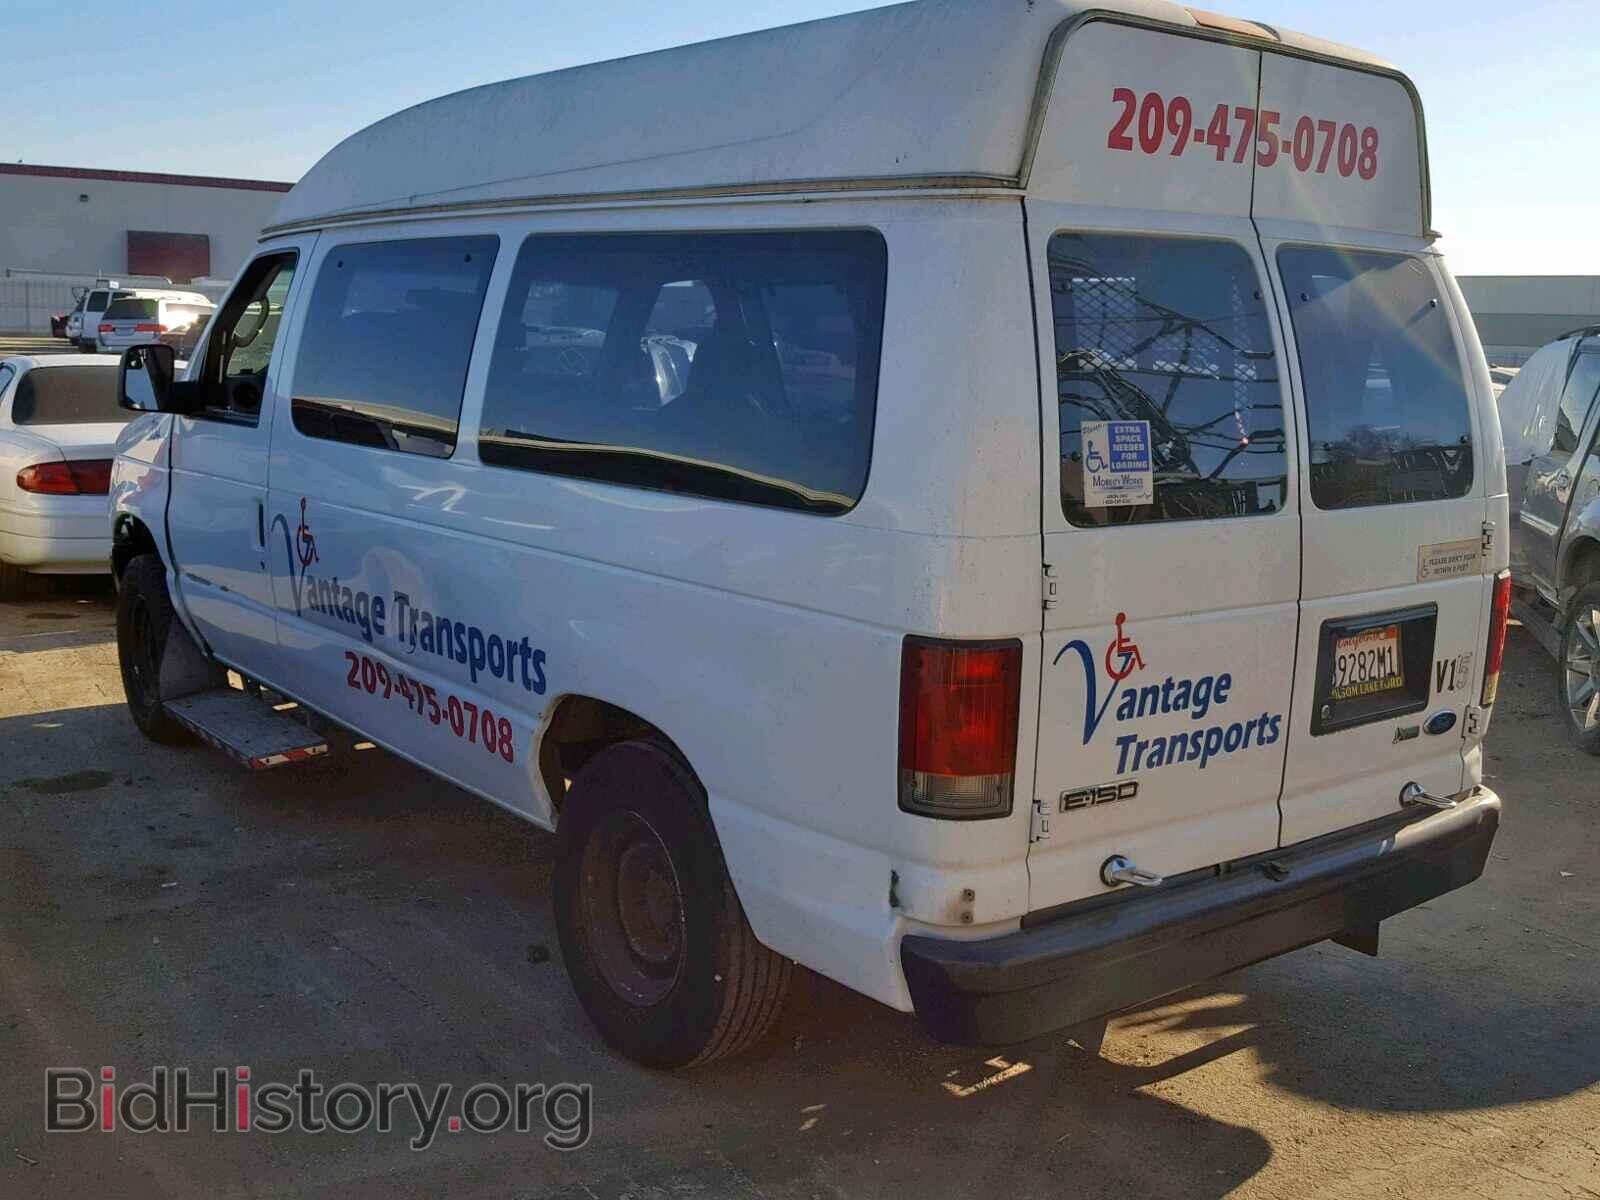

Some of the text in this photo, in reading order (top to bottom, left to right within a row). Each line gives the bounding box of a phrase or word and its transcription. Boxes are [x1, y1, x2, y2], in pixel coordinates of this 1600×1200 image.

[1107, 87, 1379, 181] 209-475-0708
[1111, 460, 1148, 470] LOADING
[1112, 443, 1145, 452] NEEDED
[1114, 434, 1142, 443] SPACE
[1121, 452, 1138, 460] FOR
[271, 513, 547, 695] Vantage Transports
[344, 651, 514, 764] 209-475-0708
[1053, 639, 1232, 745] Vantage
[1115, 712, 1282, 775] Transports
